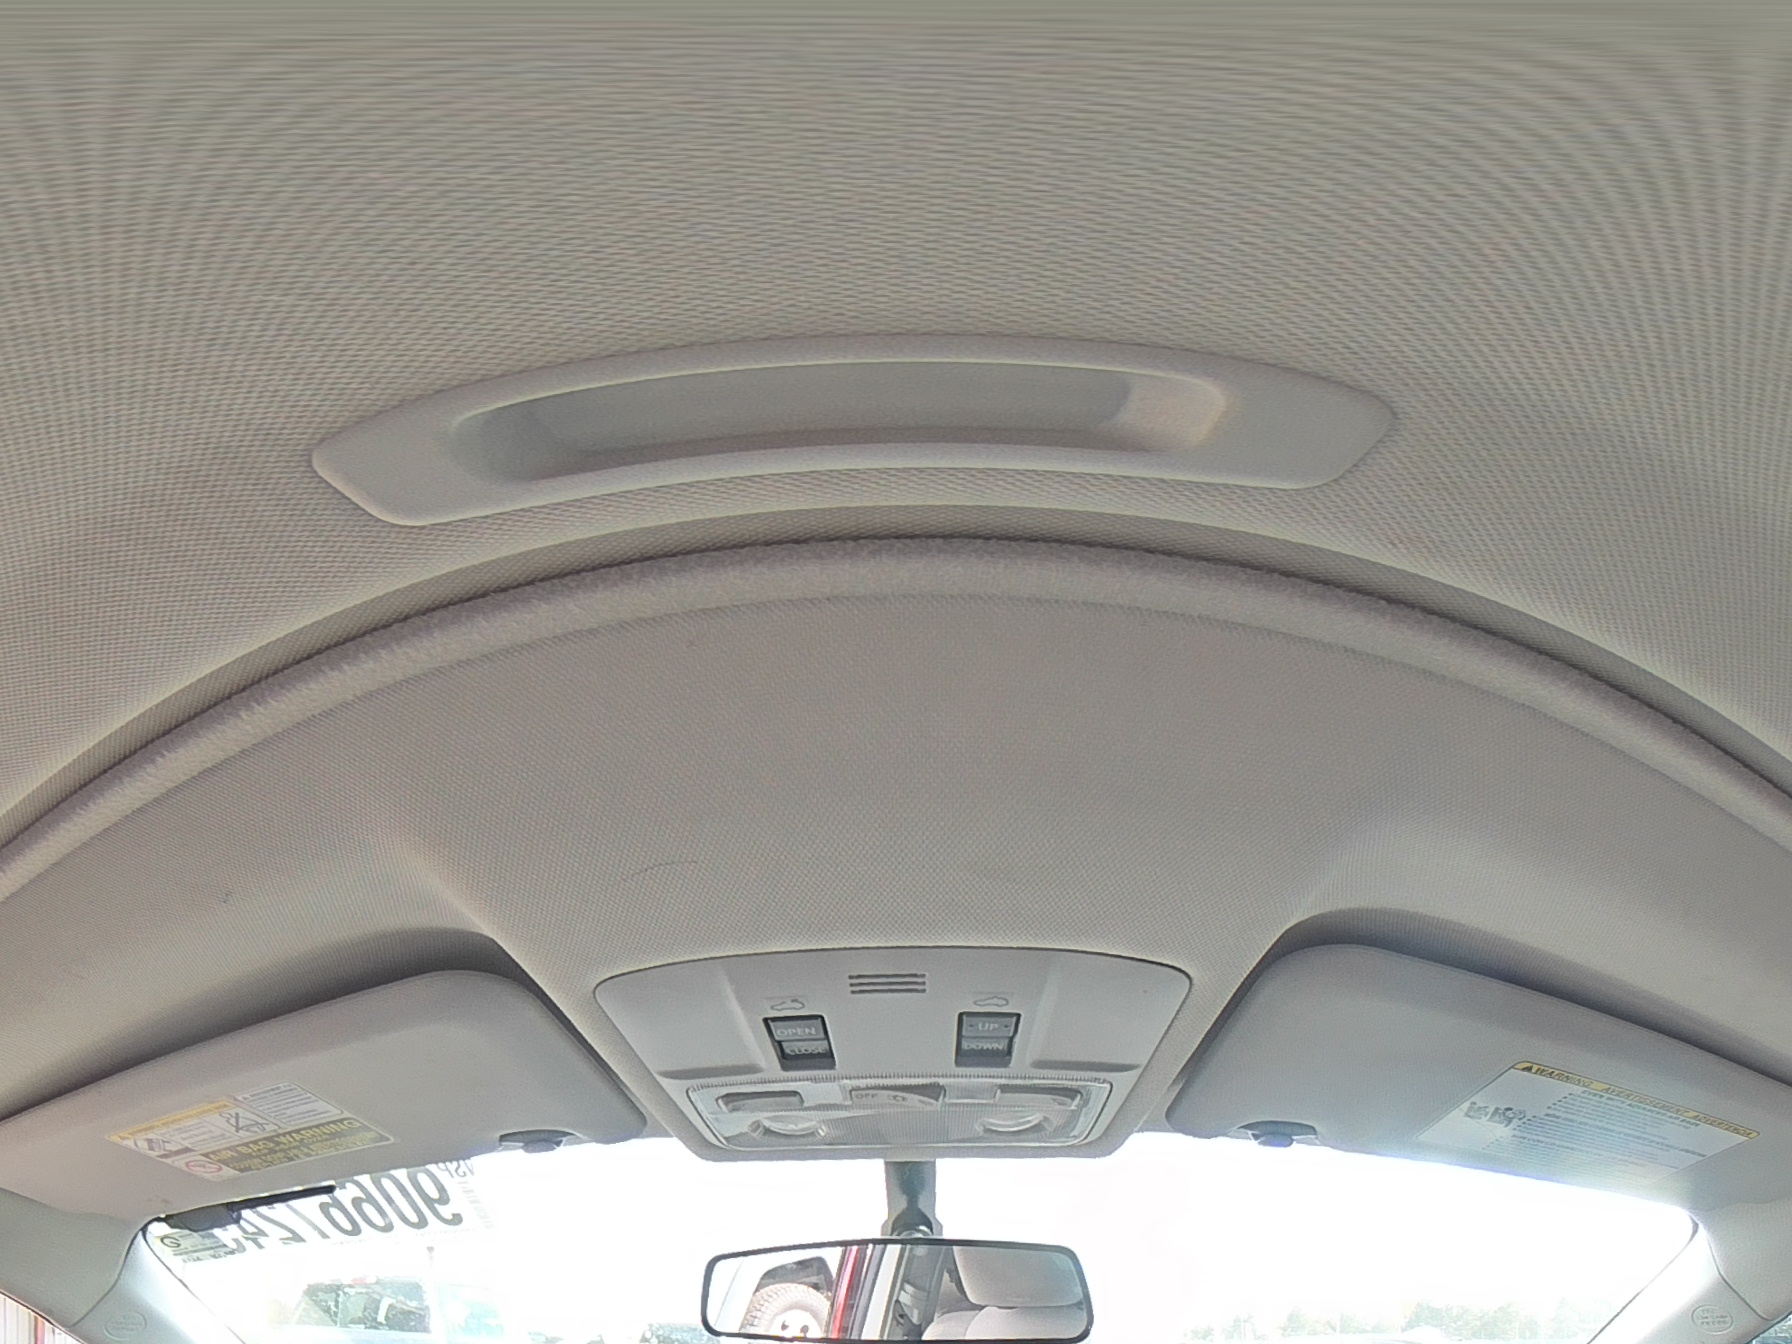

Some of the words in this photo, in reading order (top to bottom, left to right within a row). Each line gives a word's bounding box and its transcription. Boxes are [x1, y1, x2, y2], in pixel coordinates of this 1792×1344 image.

[776, 1027, 816, 1037] OPEN
[977, 1022, 1000, 1032] UP
[963, 1041, 1004, 1051] DOWN
[1533, 1066, 1594, 1088] WARNING
[209, 1148, 238, 1162] AIR
[240, 1139, 275, 1155] BAG
[276, 1119, 362, 1146] WARNING
